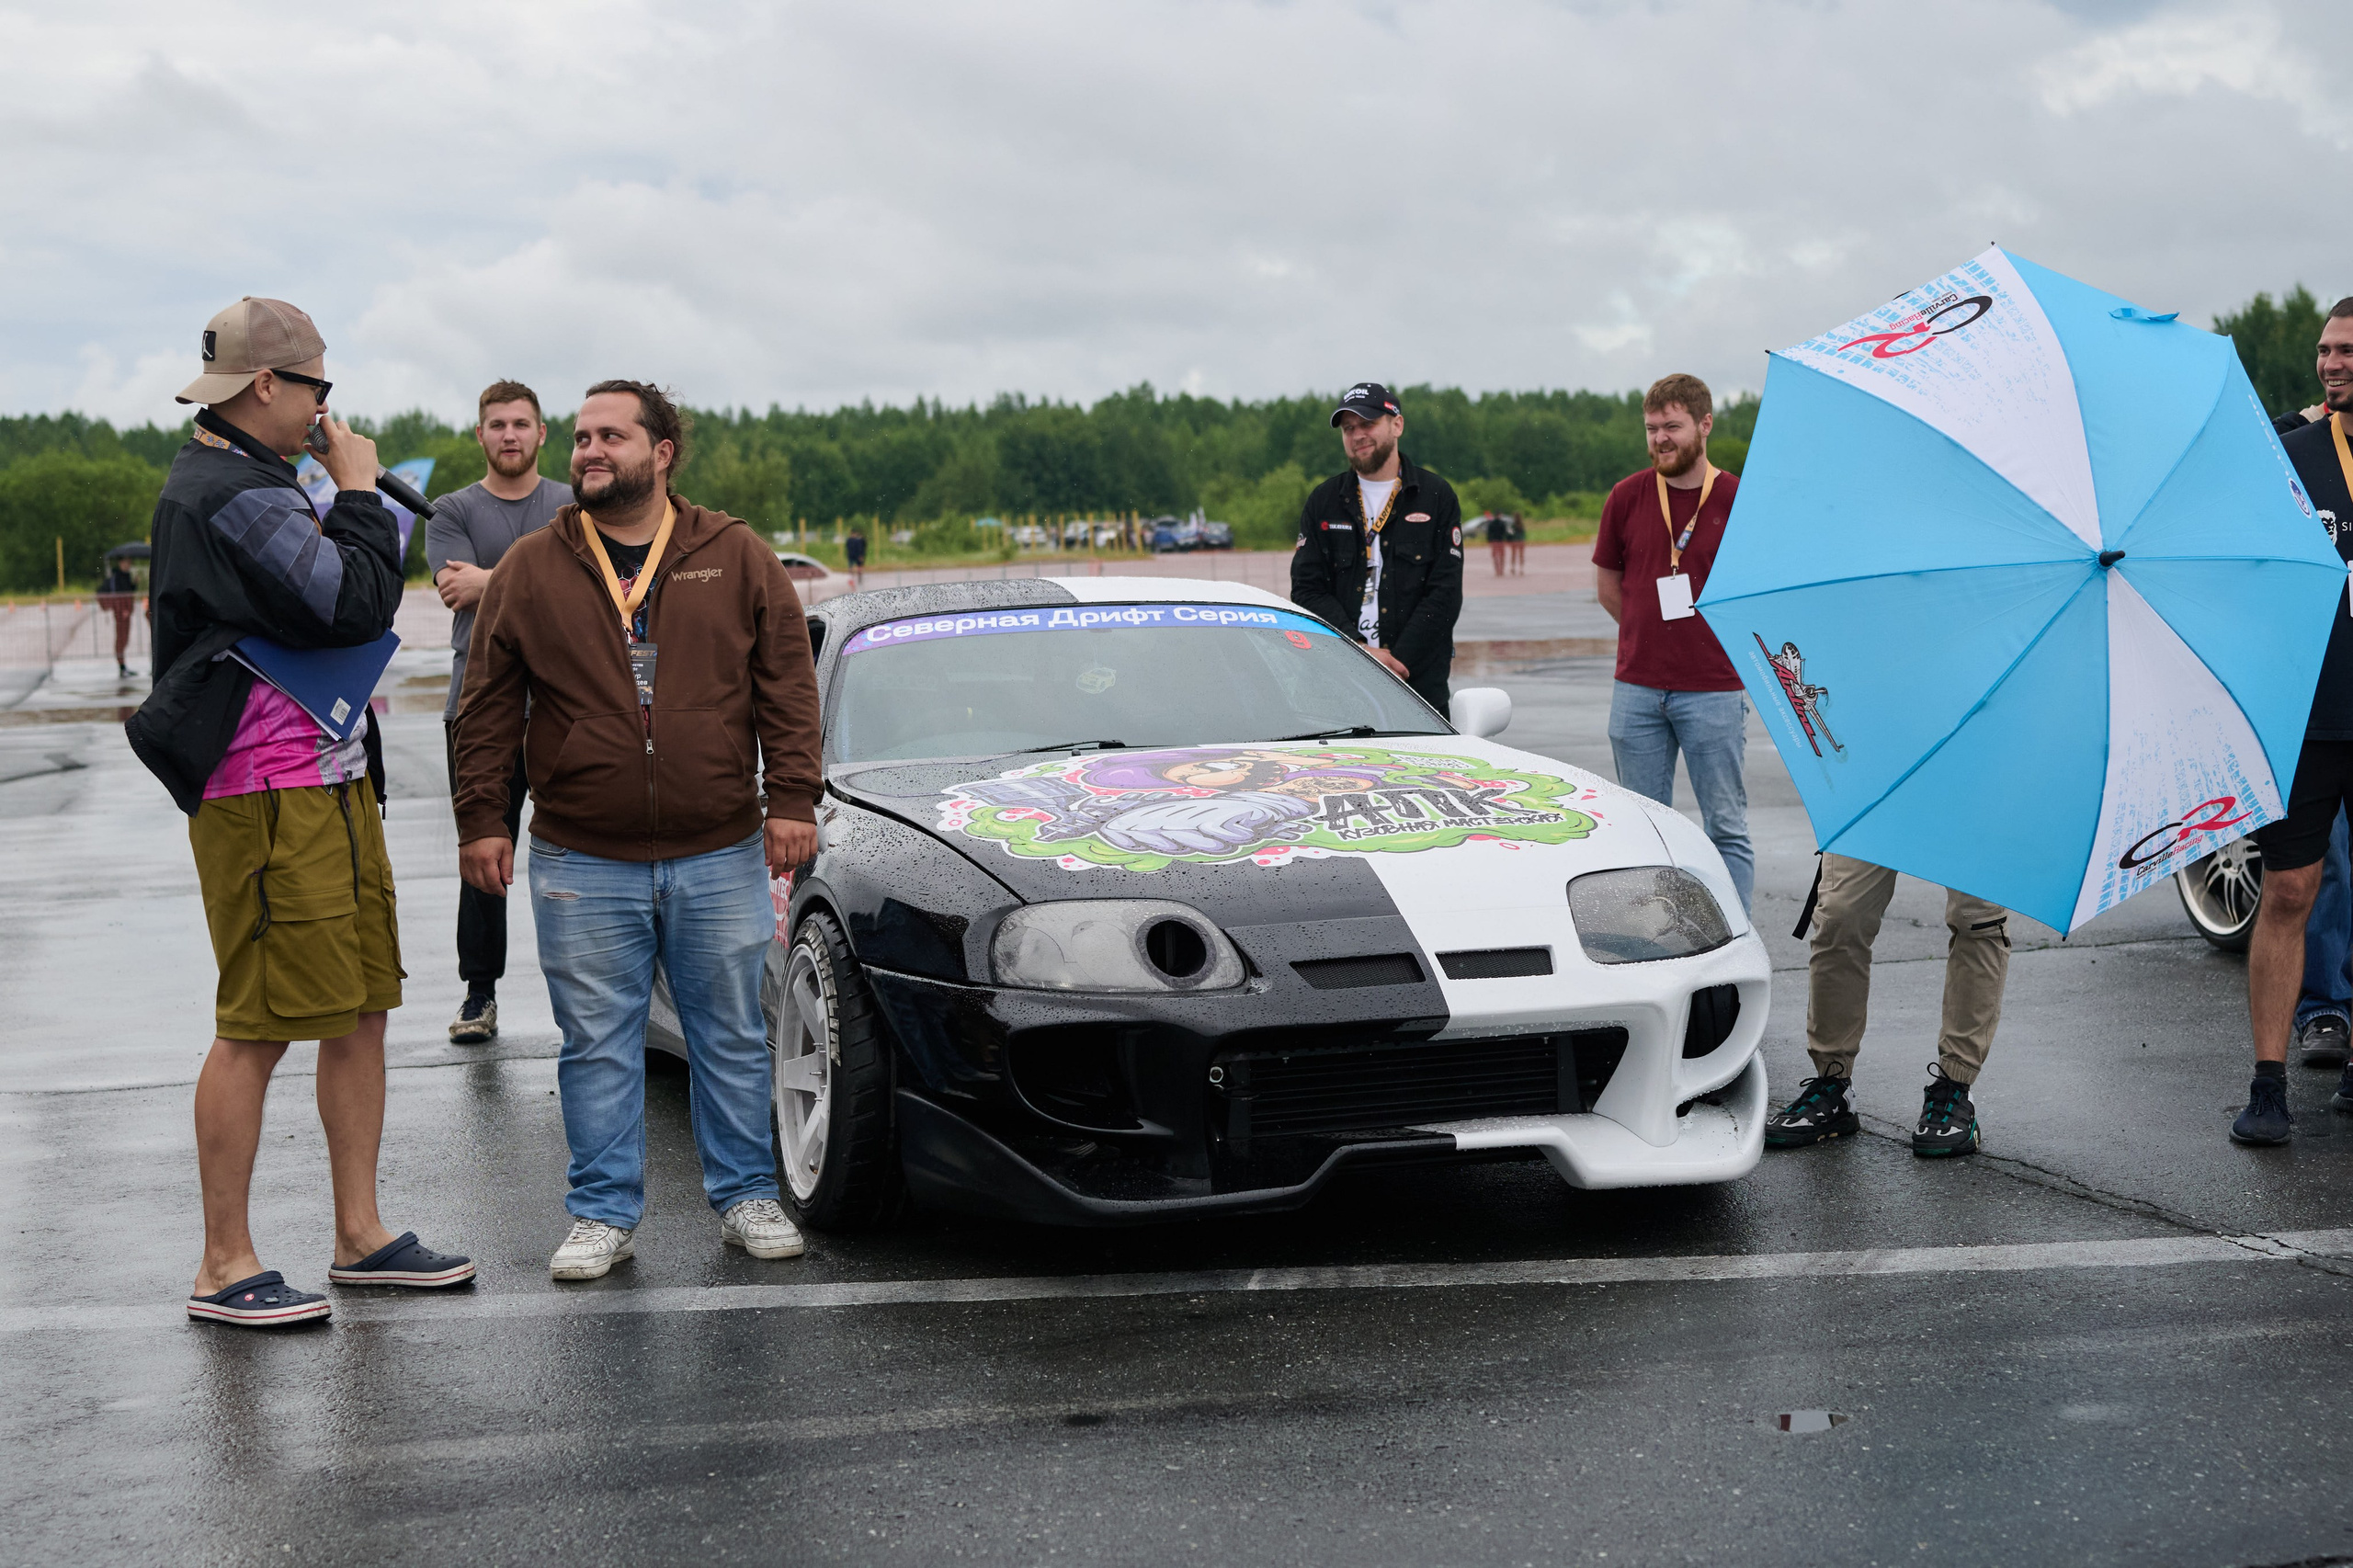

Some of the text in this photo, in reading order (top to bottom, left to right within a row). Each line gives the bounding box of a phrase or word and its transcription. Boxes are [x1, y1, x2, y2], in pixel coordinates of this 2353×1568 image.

[1375, 492, 1395, 528] CARFEST
[671, 567, 723, 583] Wrangler
[867, 607, 1279, 642] Северная Дрифт Серия
[1748, 651, 1802, 749] автомобильные аксессуары
